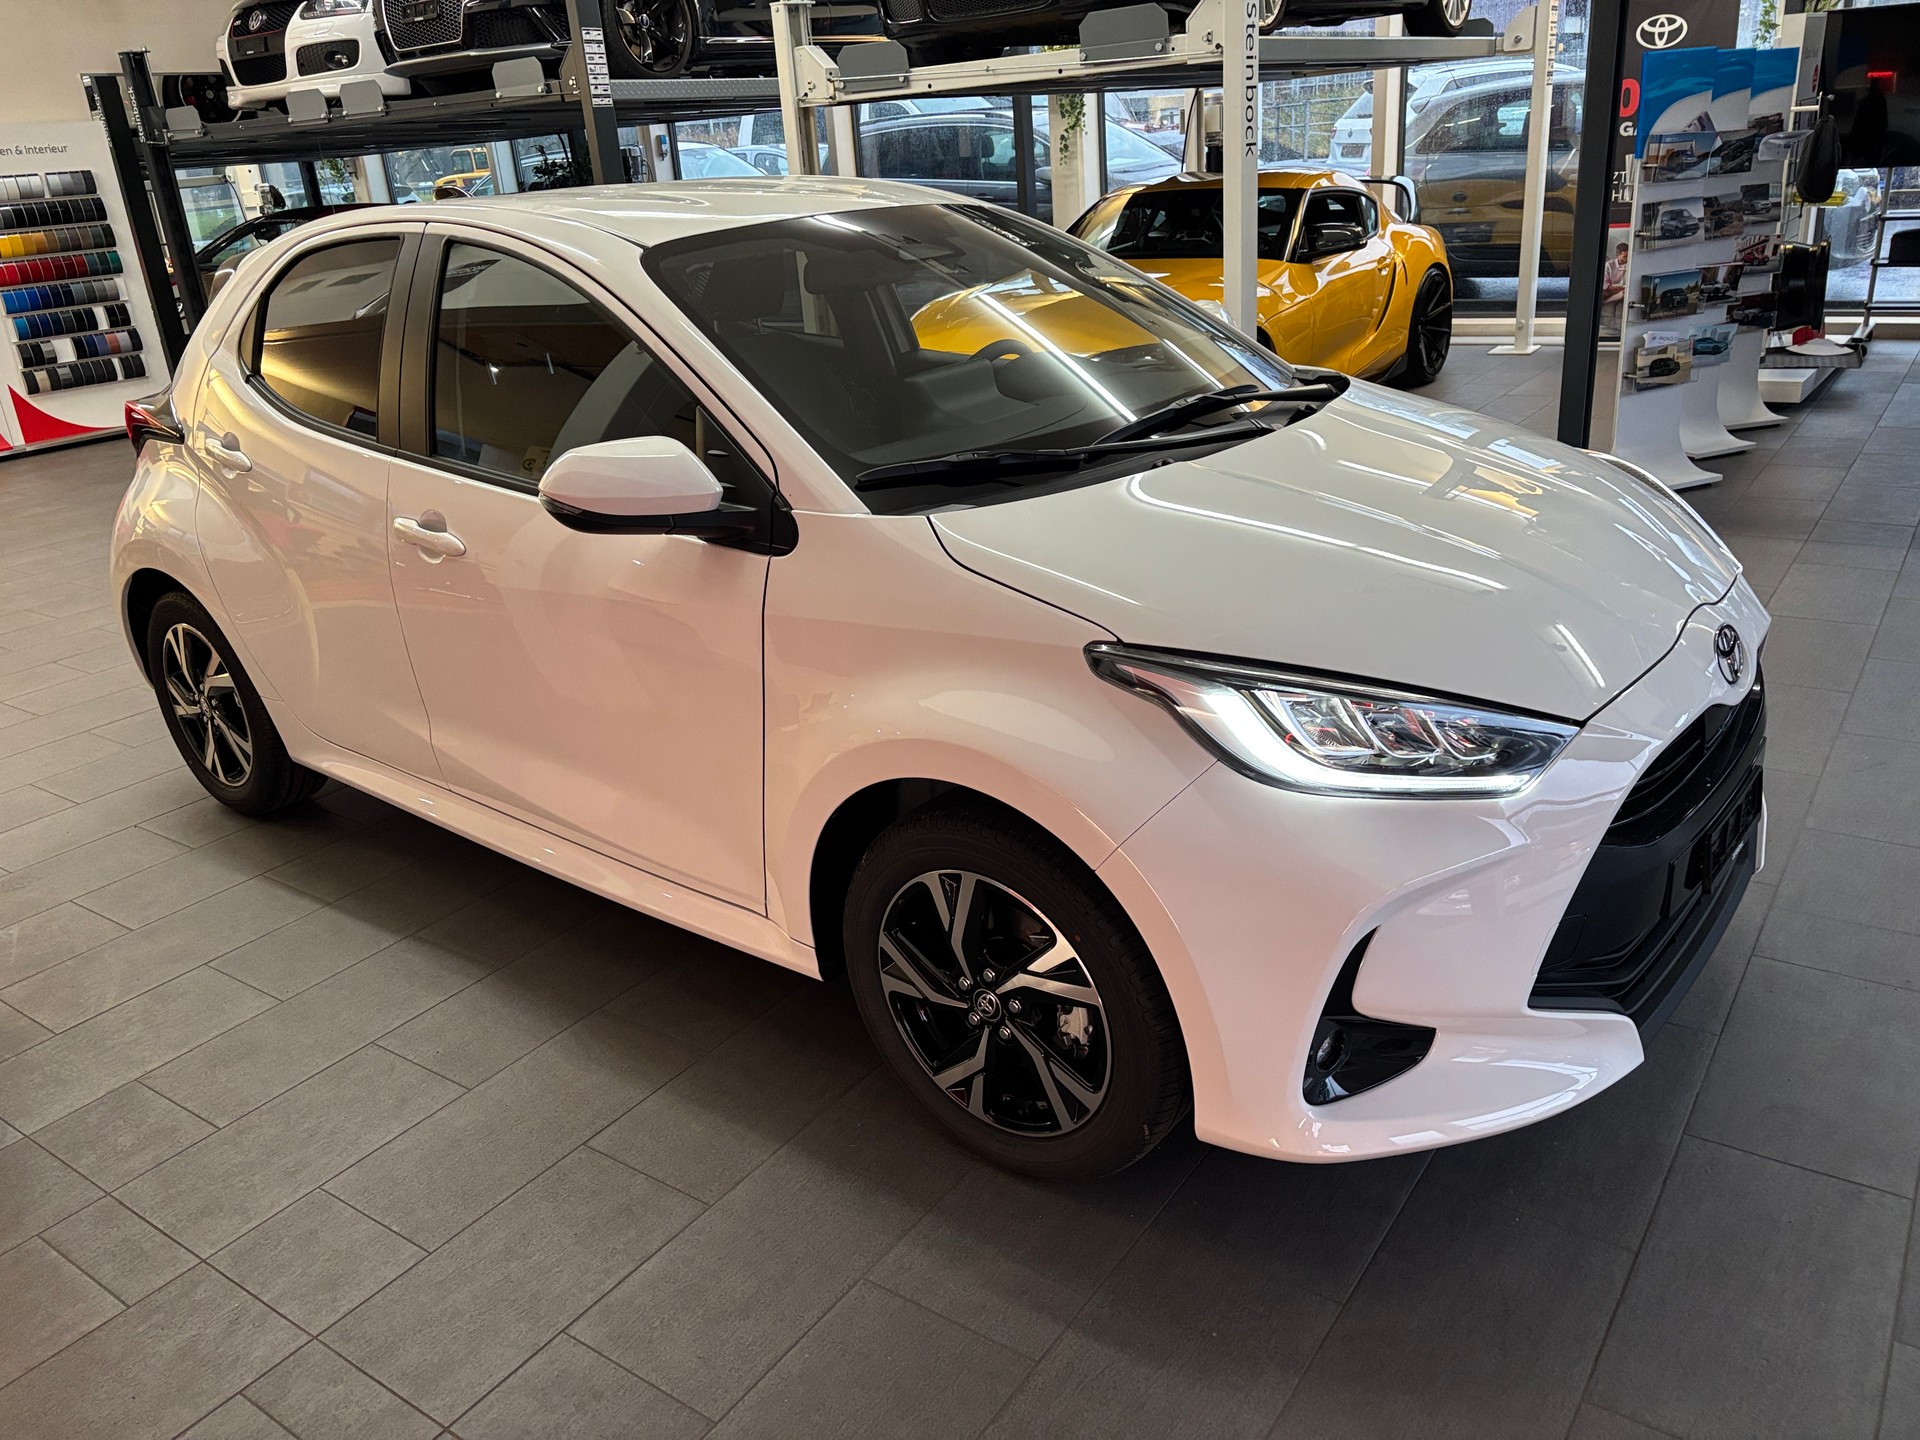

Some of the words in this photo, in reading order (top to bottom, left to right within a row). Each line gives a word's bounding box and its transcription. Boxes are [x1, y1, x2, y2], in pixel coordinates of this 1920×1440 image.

[1245, 2, 1257, 157] Steinbock
[128, 86, 145, 142] Steinbock
[14, 145, 23, 155] &
[24, 144, 68, 154] Interieur
